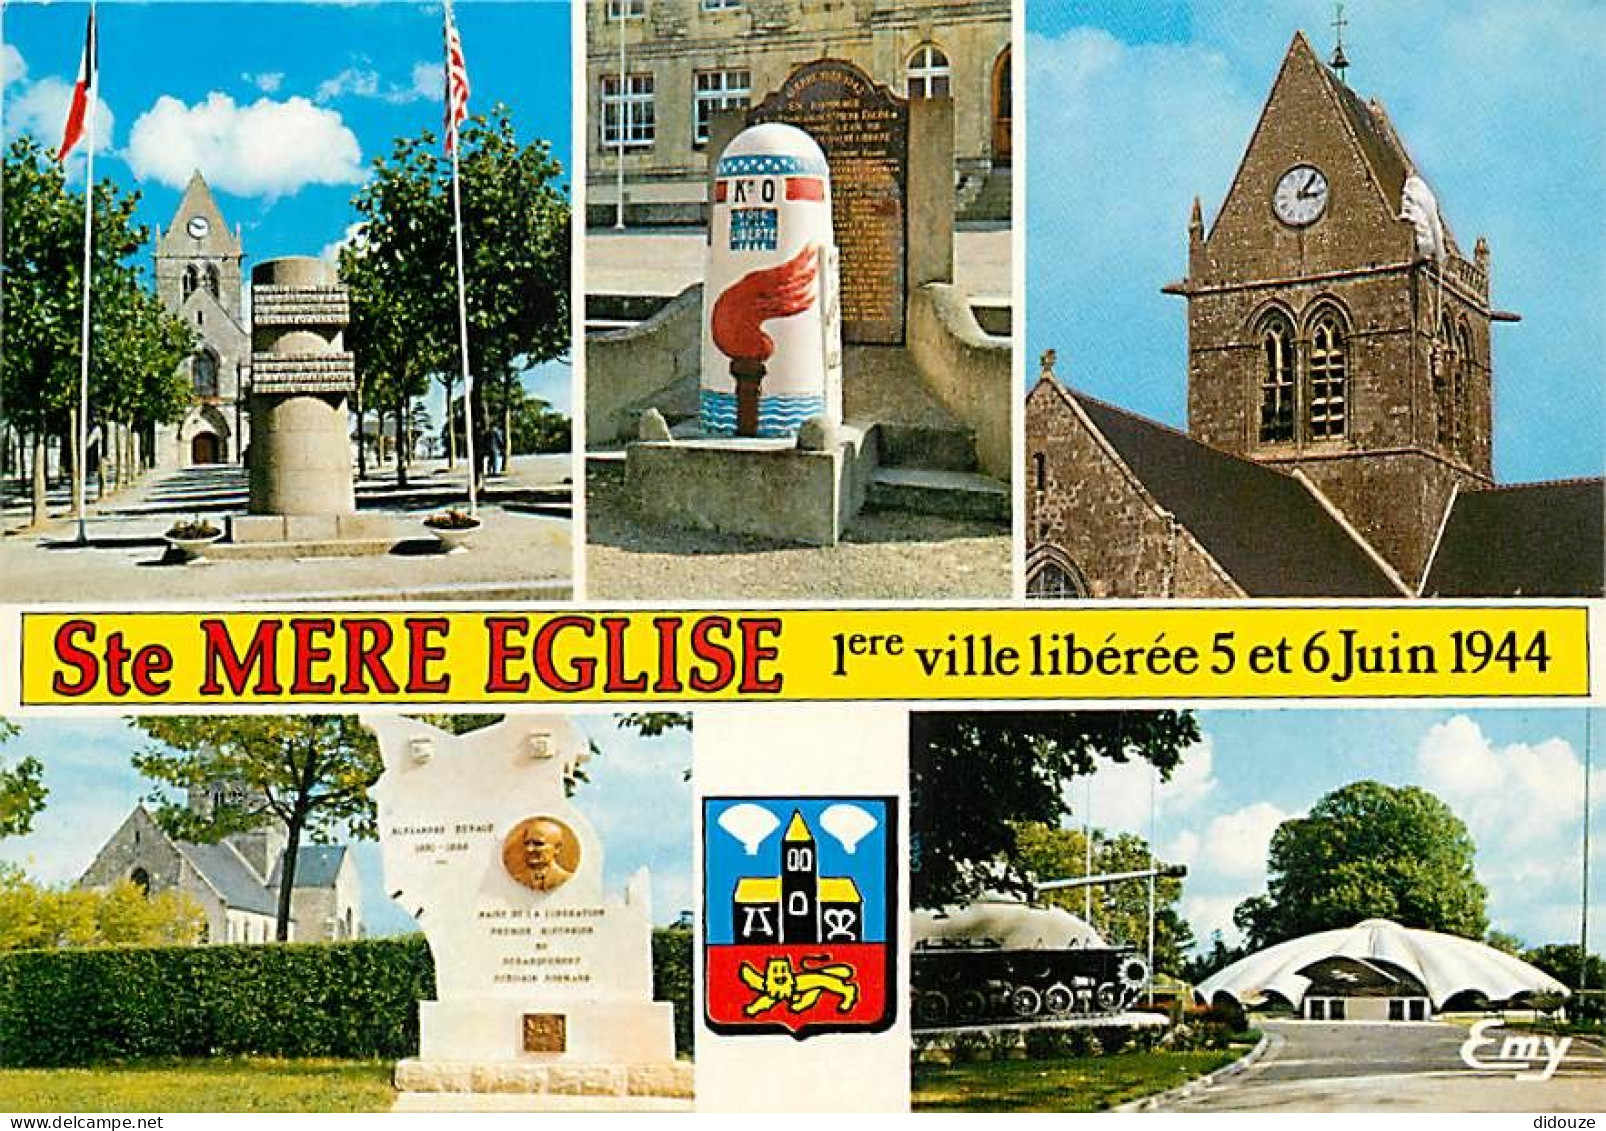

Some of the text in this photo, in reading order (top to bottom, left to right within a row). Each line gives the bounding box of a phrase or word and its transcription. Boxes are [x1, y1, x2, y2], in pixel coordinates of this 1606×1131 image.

[53, 615, 783, 697] Ste MERE EGLISE
[915, 634, 1020, 675] ville
[1031, 632, 1199, 675] libérée
[1210, 632, 1236, 674] 5
[1248, 637, 1292, 674] et
[1303, 631, 1330, 673] 6
[1331, 629, 1438, 683] Juin
[1450, 630, 1551, 674] 1944
